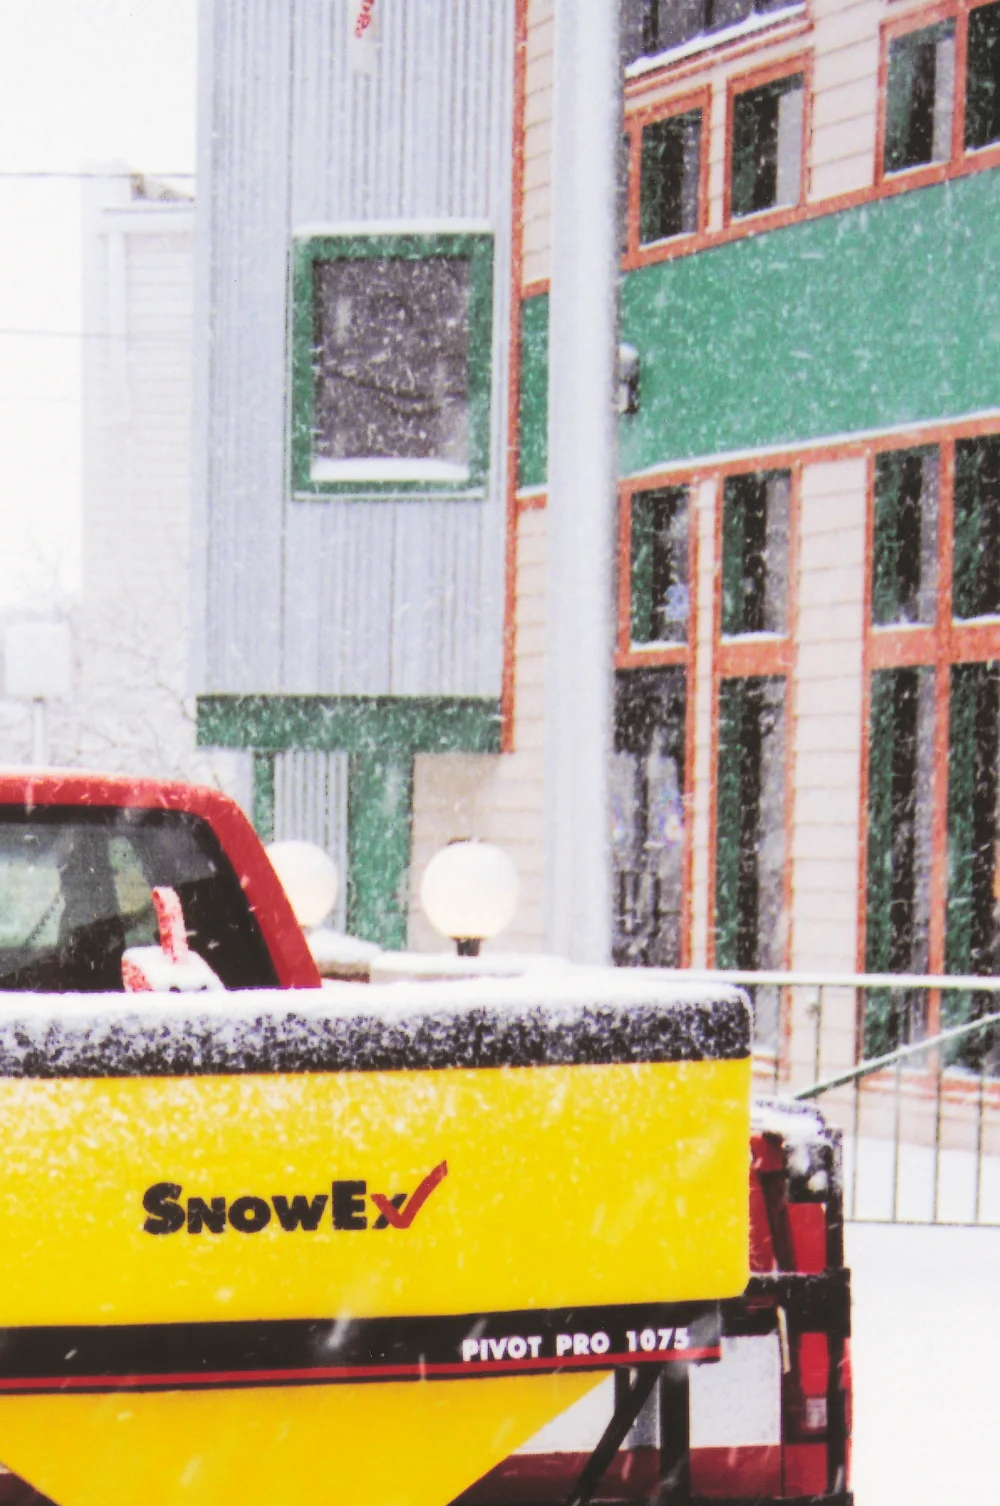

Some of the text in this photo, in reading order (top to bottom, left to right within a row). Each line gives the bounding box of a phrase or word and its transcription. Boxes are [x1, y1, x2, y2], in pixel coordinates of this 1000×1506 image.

[462, 1327, 690, 1362] PIVOT PRO 1075
